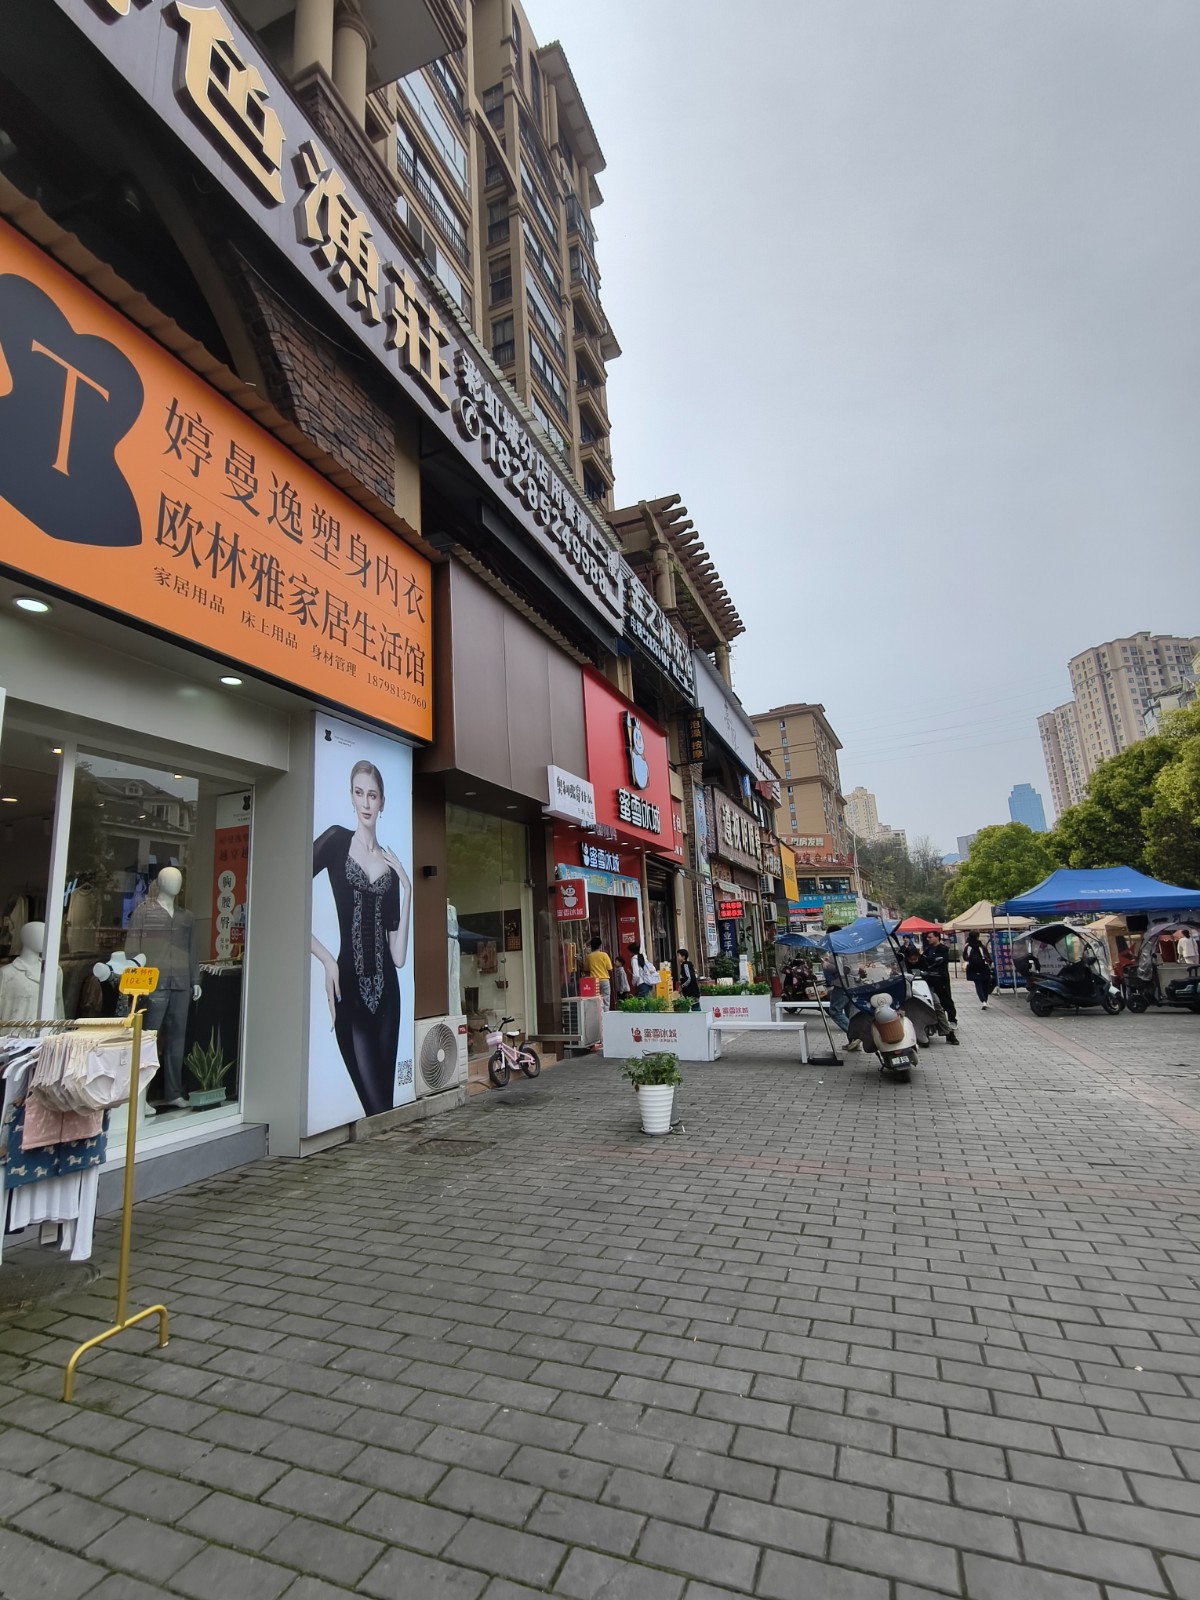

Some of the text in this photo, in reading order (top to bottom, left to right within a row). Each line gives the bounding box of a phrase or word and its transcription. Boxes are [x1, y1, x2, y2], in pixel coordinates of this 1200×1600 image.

[107, 0, 450, 410] 色漁莊
[32, 339, 109, 477] T
[154, 491, 426, 686] 欧林雅家居生活馆
[163, 397, 426, 624] 婷曼逸塑身内衣
[483, 427, 606, 595] 18285249988
[153, 566, 427, 710] 家居用品 床上用品 身材管理 18798137960
[619, 788, 660, 833] 蜜雪冰城
